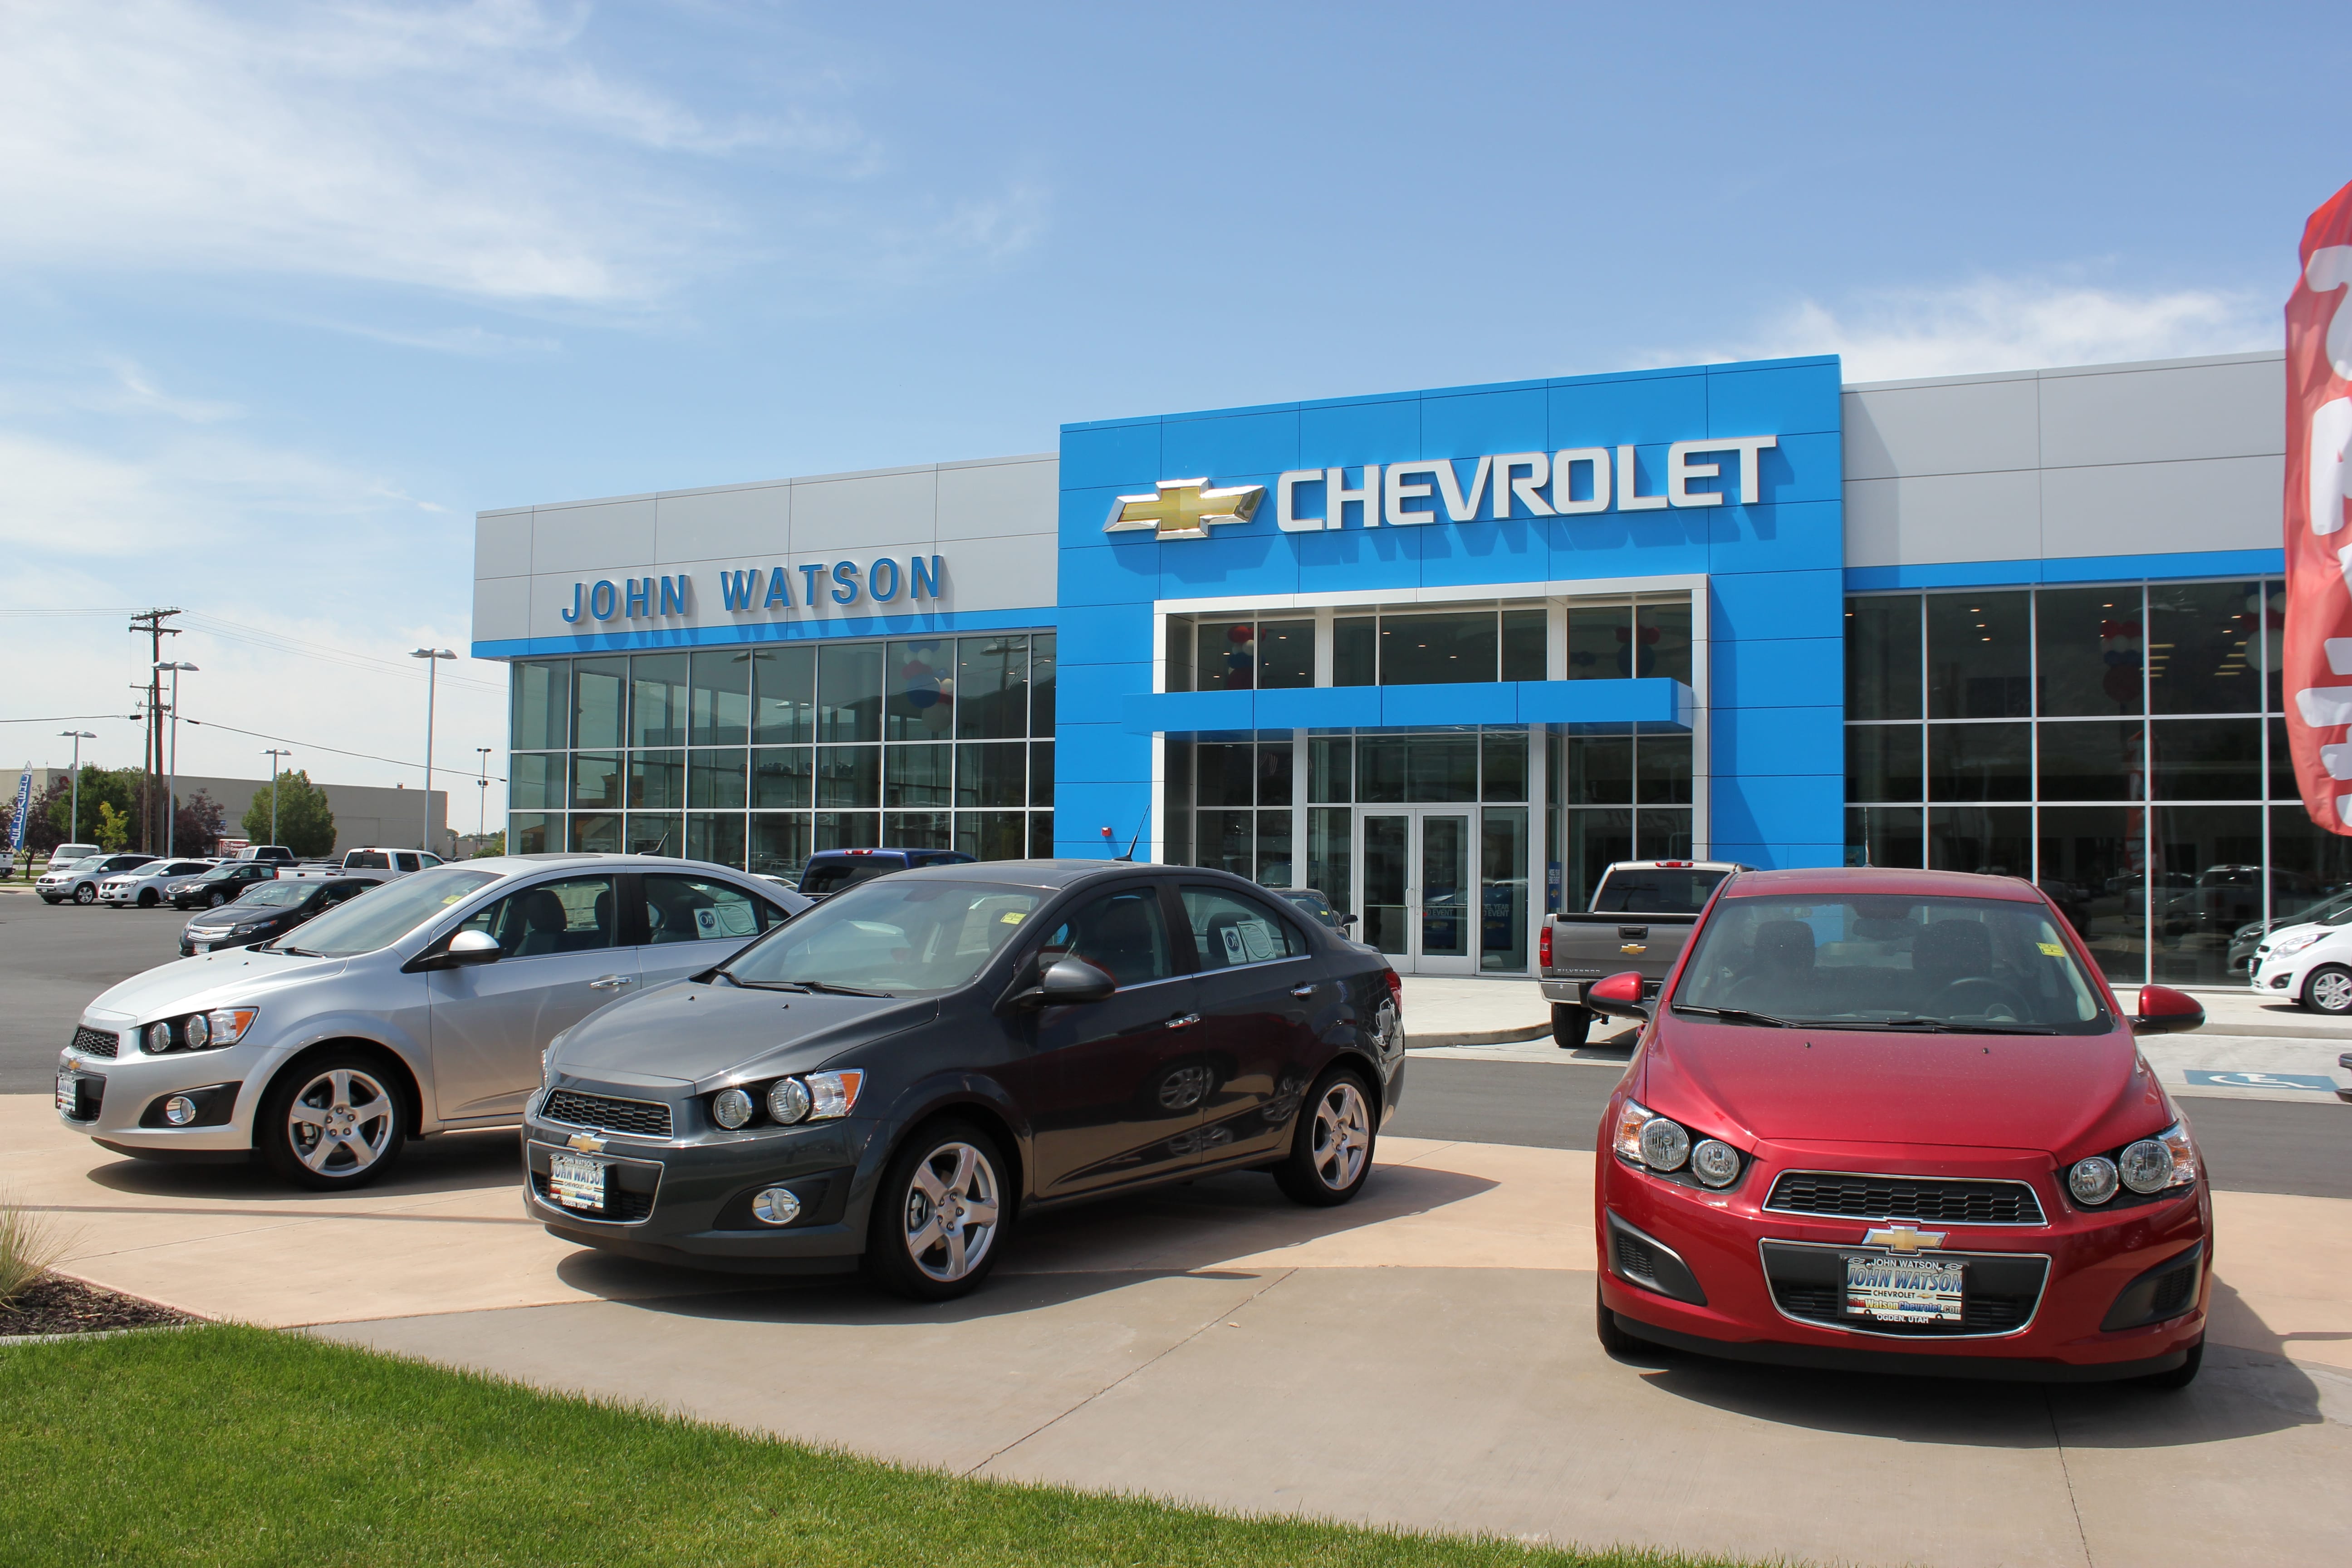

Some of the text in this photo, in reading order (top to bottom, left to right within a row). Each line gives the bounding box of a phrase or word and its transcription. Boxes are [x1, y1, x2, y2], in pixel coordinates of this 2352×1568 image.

[1277, 435, 1777, 532] CHEVROLET
[562, 555, 944, 624] JOHN WATSON
[562, 1155, 595, 1168] JOHN WATSON
[551, 1163, 573, 1180] JOHN
[1871, 1258, 1938, 1269] JOHN WATSON
[1847, 1268, 1962, 1293] JOHN WATSON
[1873, 1289, 1916, 1298] CHEVROLET
[1908, 1316, 1929, 1324] UTAH
